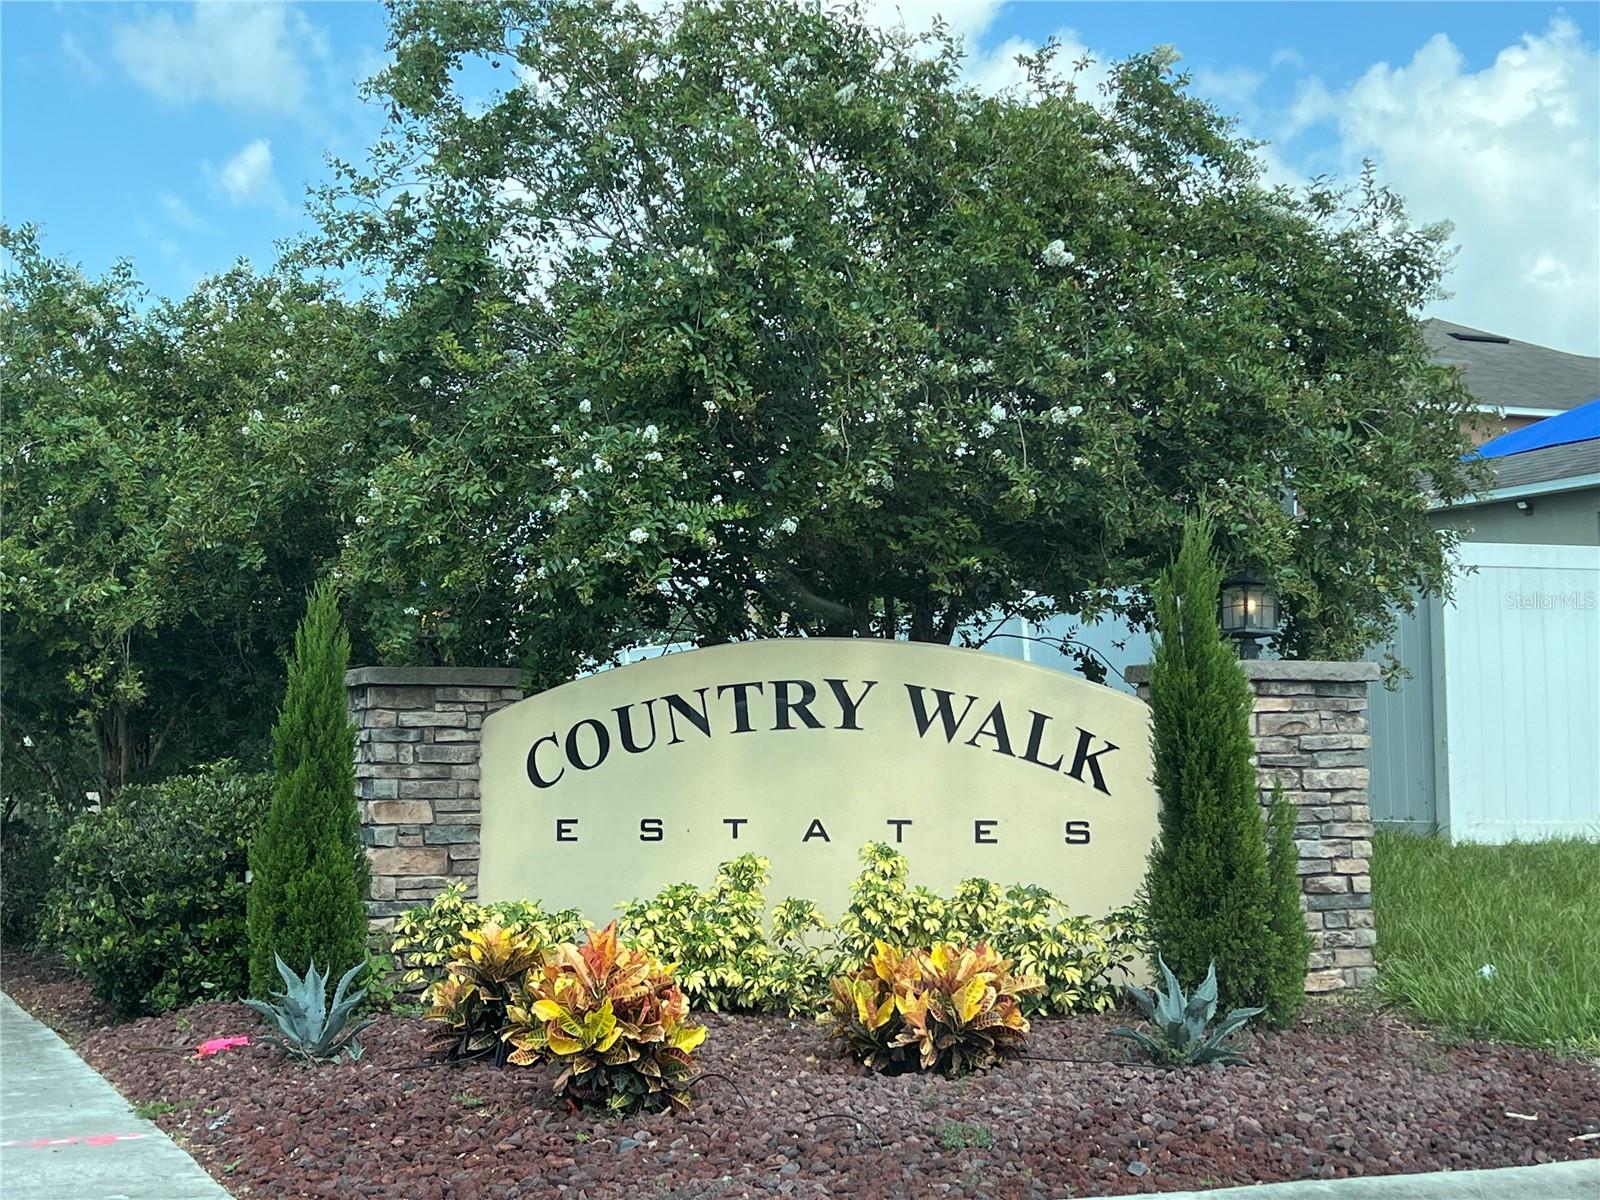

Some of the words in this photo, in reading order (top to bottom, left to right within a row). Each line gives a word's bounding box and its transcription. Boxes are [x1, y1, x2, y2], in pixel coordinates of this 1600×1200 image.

[526, 678, 878, 789] COUNTRY
[903, 683, 1120, 796] WALK
[556, 818, 1091, 845] ESTATES
